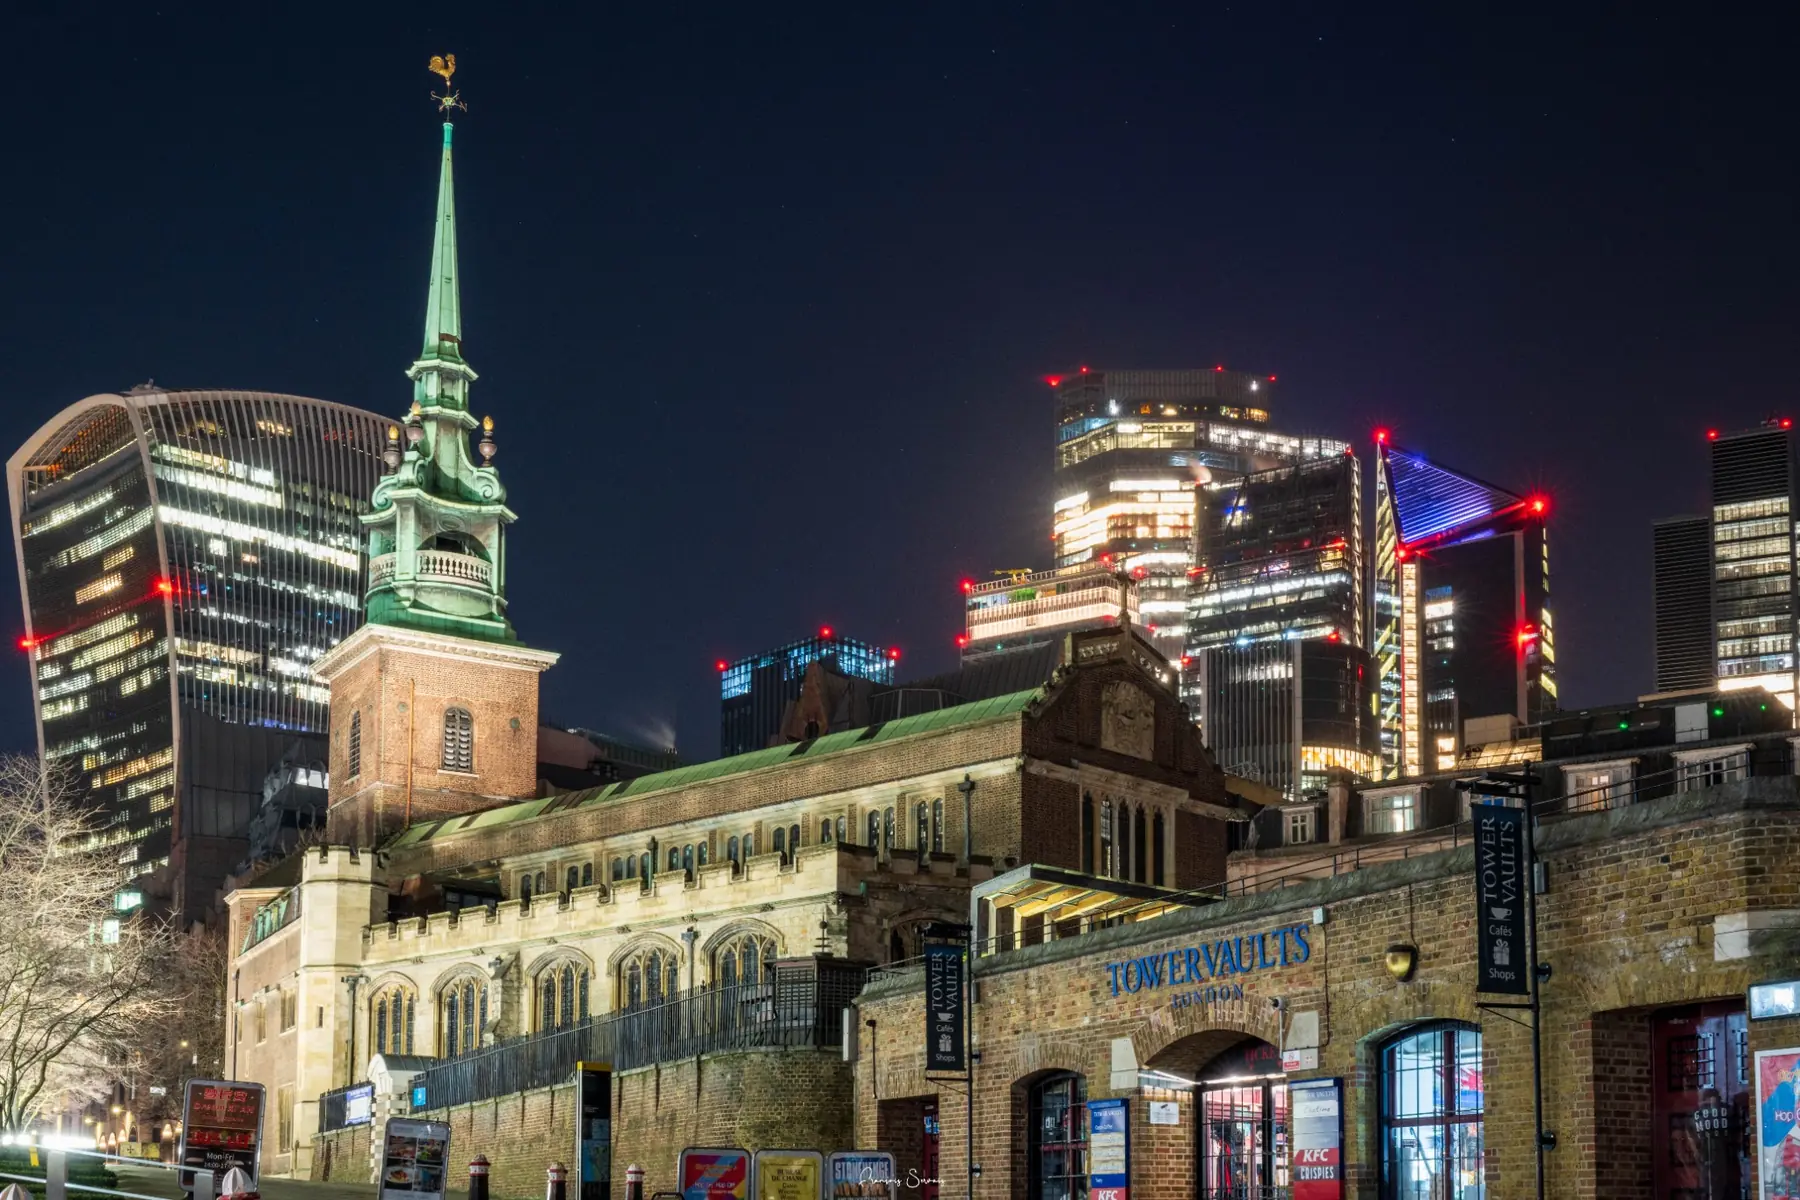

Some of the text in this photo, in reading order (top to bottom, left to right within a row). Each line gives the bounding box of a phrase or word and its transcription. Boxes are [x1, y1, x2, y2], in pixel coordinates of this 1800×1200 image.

[1481, 815, 1498, 903] TOWER
[1499, 820, 1517, 905] VAULTS
[1489, 924, 1513, 937] Cafés
[931, 951, 943, 1011] TOWER
[1488, 967, 1516, 981] Shops
[945, 953, 958, 1011] VAULTS
[1171, 983, 1244, 1009] LONDON
[935, 1052, 956, 1063] Shops
[1303, 1148, 1329, 1162] KFC
[1300, 1166, 1334, 1180] CRISPIES
[1098, 1189, 1118, 1200] KFC
